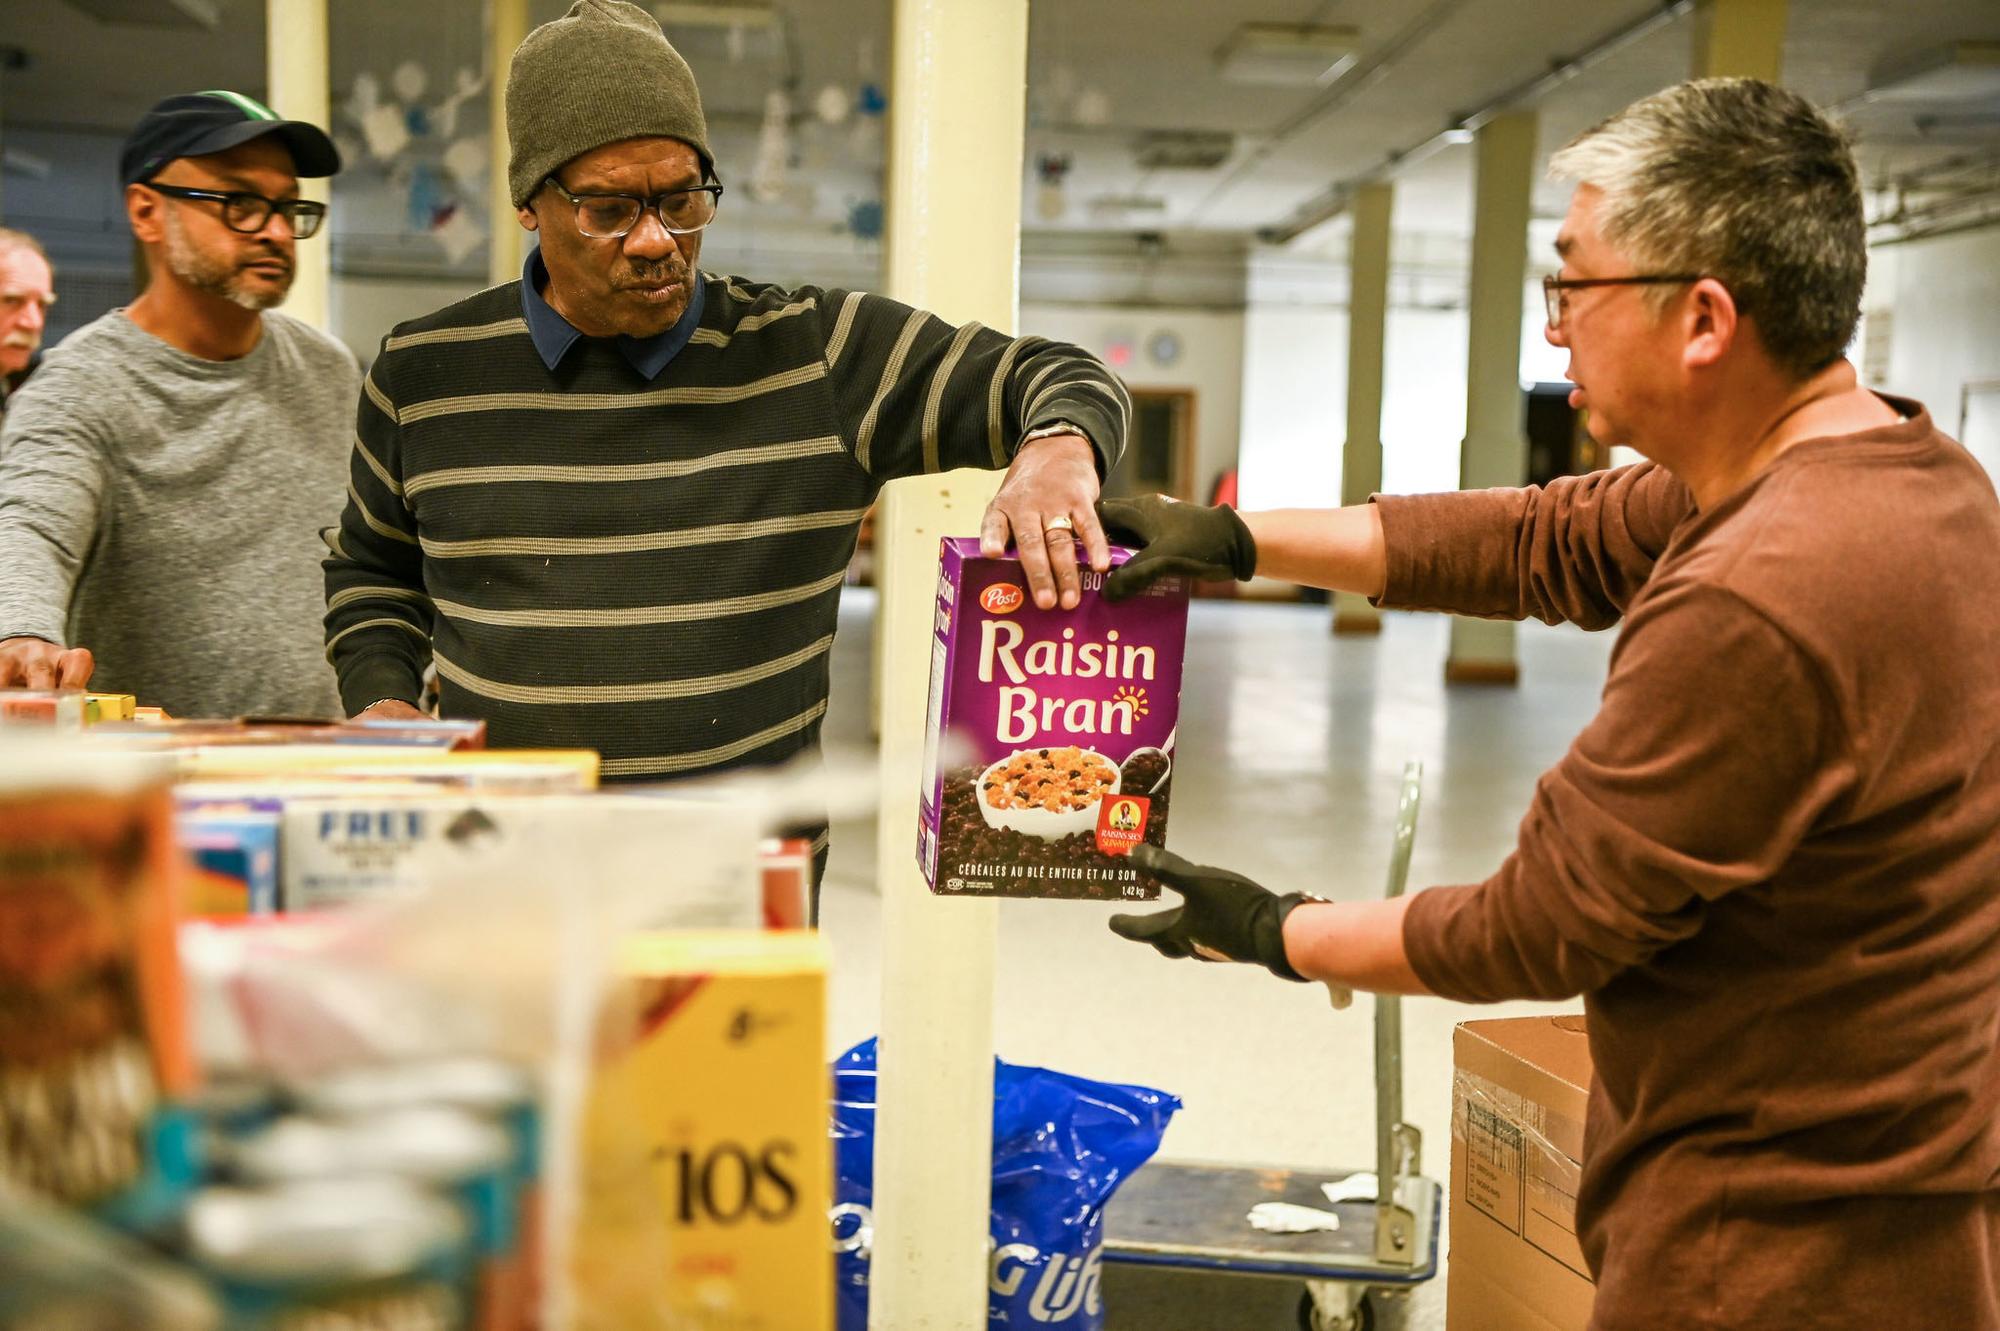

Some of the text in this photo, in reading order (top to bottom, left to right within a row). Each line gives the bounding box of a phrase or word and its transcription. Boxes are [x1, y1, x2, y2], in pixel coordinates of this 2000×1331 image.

[985, 586, 1018, 606] Post
[978, 620, 1155, 684] Raisin
[996, 686, 1134, 743] Bran
[1101, 830, 1127, 840] RAISINS
[958, 862, 1137, 881] CÉRÉALES AU BLÉ ENTIER ET AU SON
[1136, 886, 1145, 898] kg
